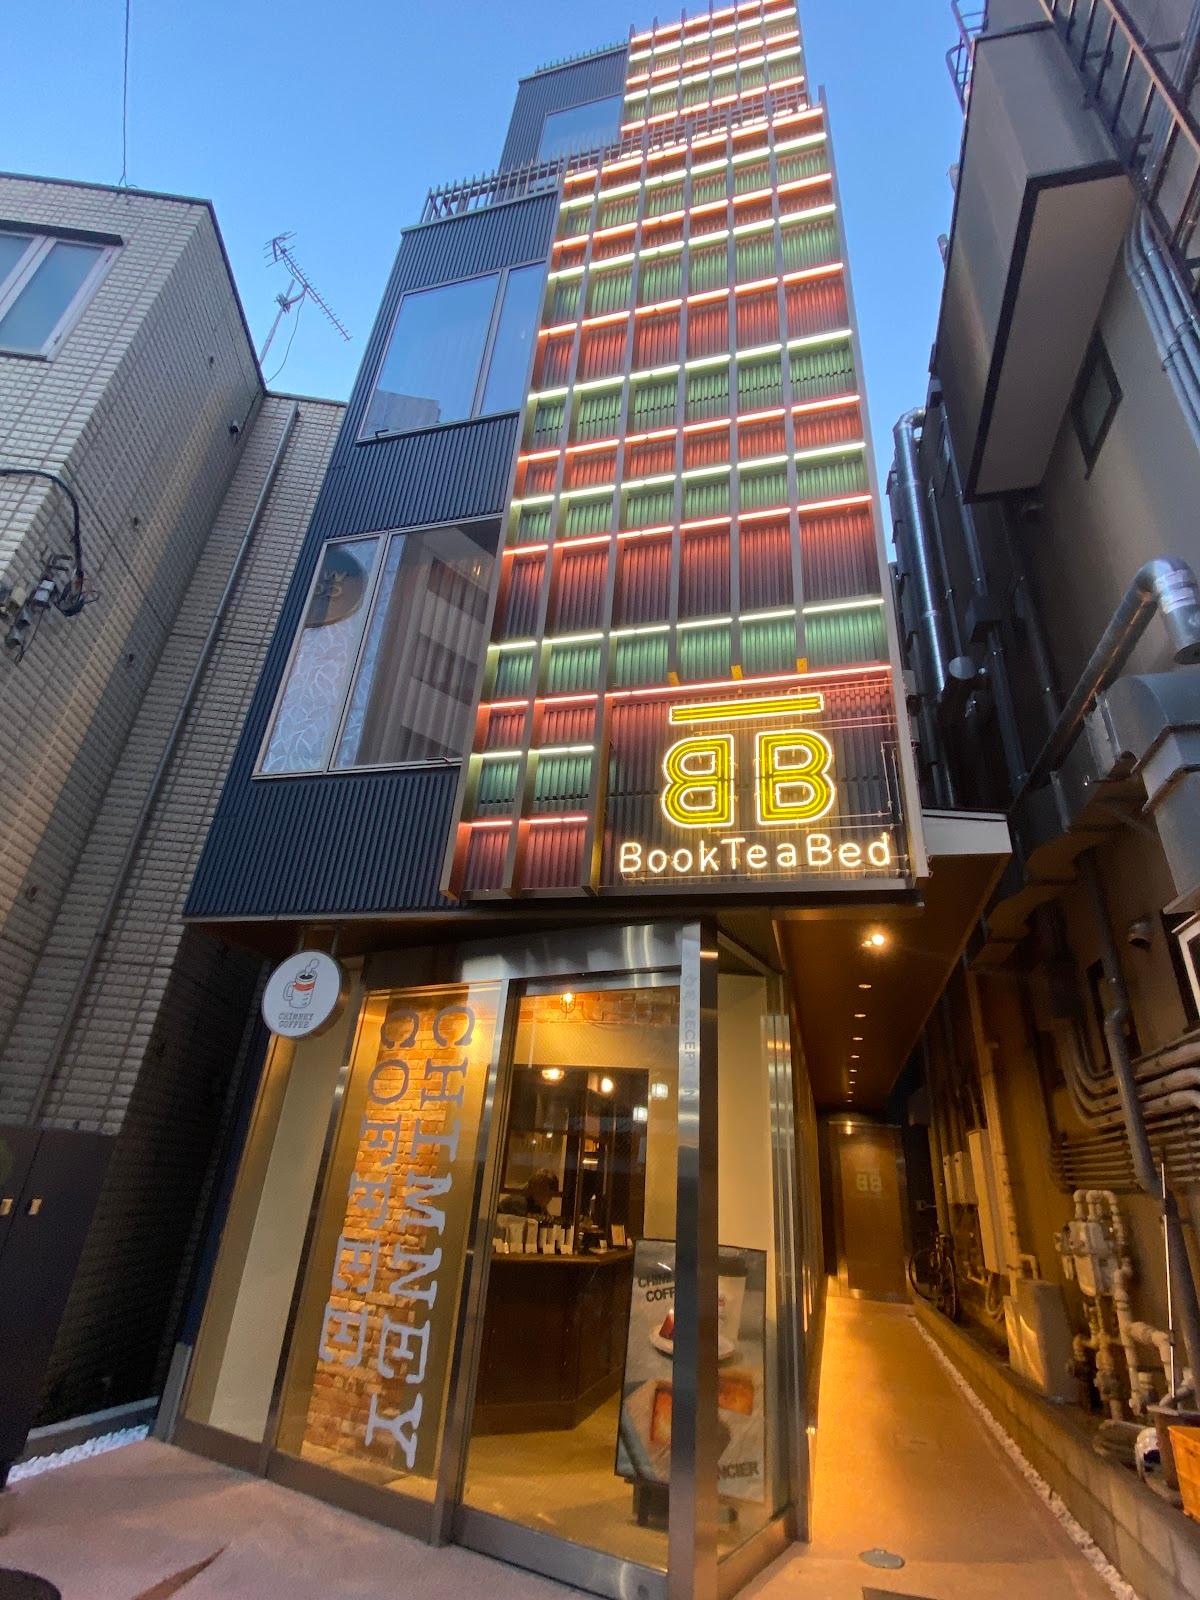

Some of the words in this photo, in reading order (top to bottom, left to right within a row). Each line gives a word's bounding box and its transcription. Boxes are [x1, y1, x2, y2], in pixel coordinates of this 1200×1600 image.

[619, 831, 891, 873] BookTeaBed
[279, 1020, 309, 1028] COFFEE
[318, 1011, 420, 1367] COFFEE
[364, 1005, 476, 1469] CHIMNEY
[646, 1286, 675, 1302] COFF
